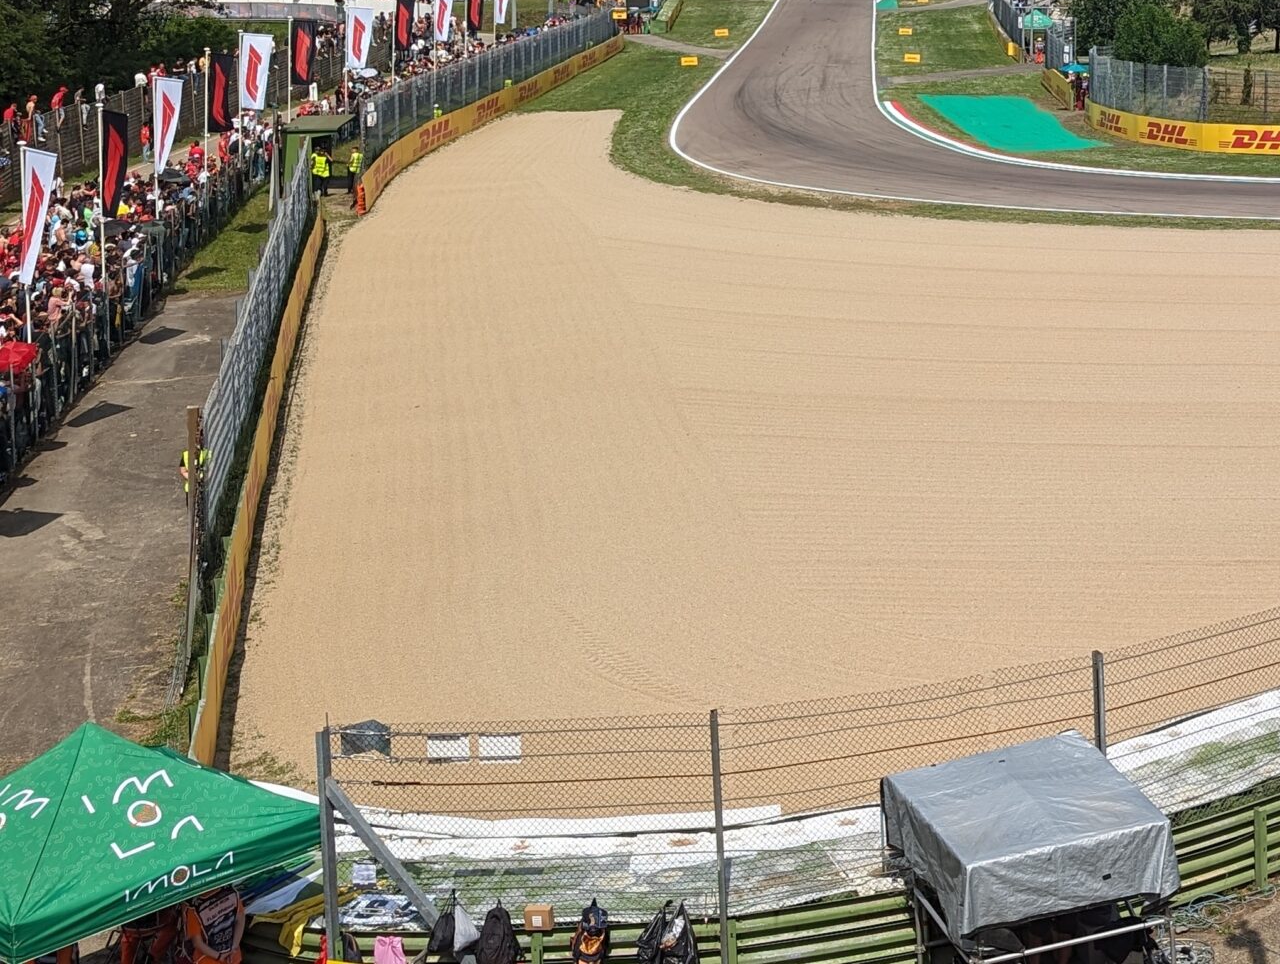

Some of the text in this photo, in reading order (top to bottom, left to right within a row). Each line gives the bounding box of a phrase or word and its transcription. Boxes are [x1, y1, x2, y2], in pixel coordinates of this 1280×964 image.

[553, 64, 573, 83] DHL
[518, 81, 540, 101] DHL
[476, 96, 503, 121] DHL
[419, 119, 453, 148] DHL
[1098, 110, 1123, 133] DHL
[1147, 122, 1188, 146] DHL
[372, 151, 397, 189] DHL
[124, 850, 234, 903] IMOLA
